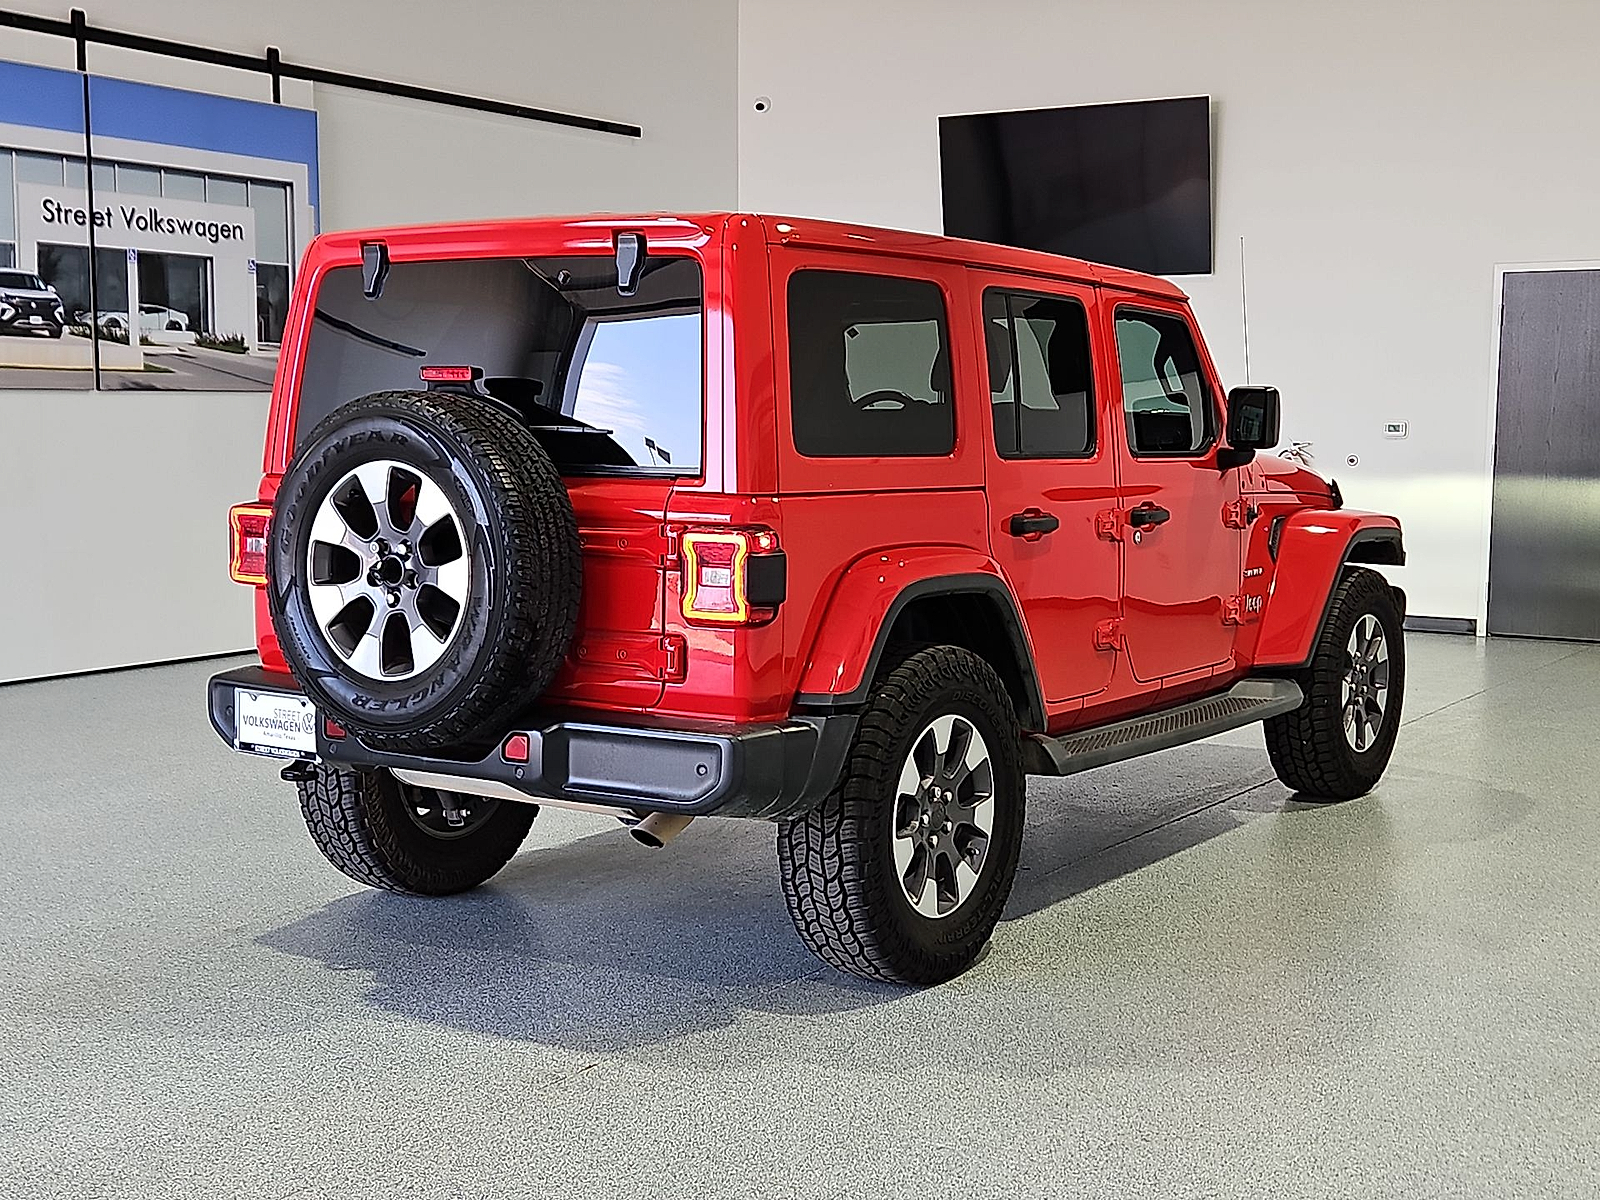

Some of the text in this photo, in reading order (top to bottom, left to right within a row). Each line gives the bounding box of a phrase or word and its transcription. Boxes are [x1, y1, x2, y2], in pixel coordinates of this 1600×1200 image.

[41, 198, 244, 243] Street Volkswagen
[1243, 594, 1263, 613] Jeep
[242, 714, 301, 732] VOLKSWAGEN
[273, 708, 301, 721] STREET
